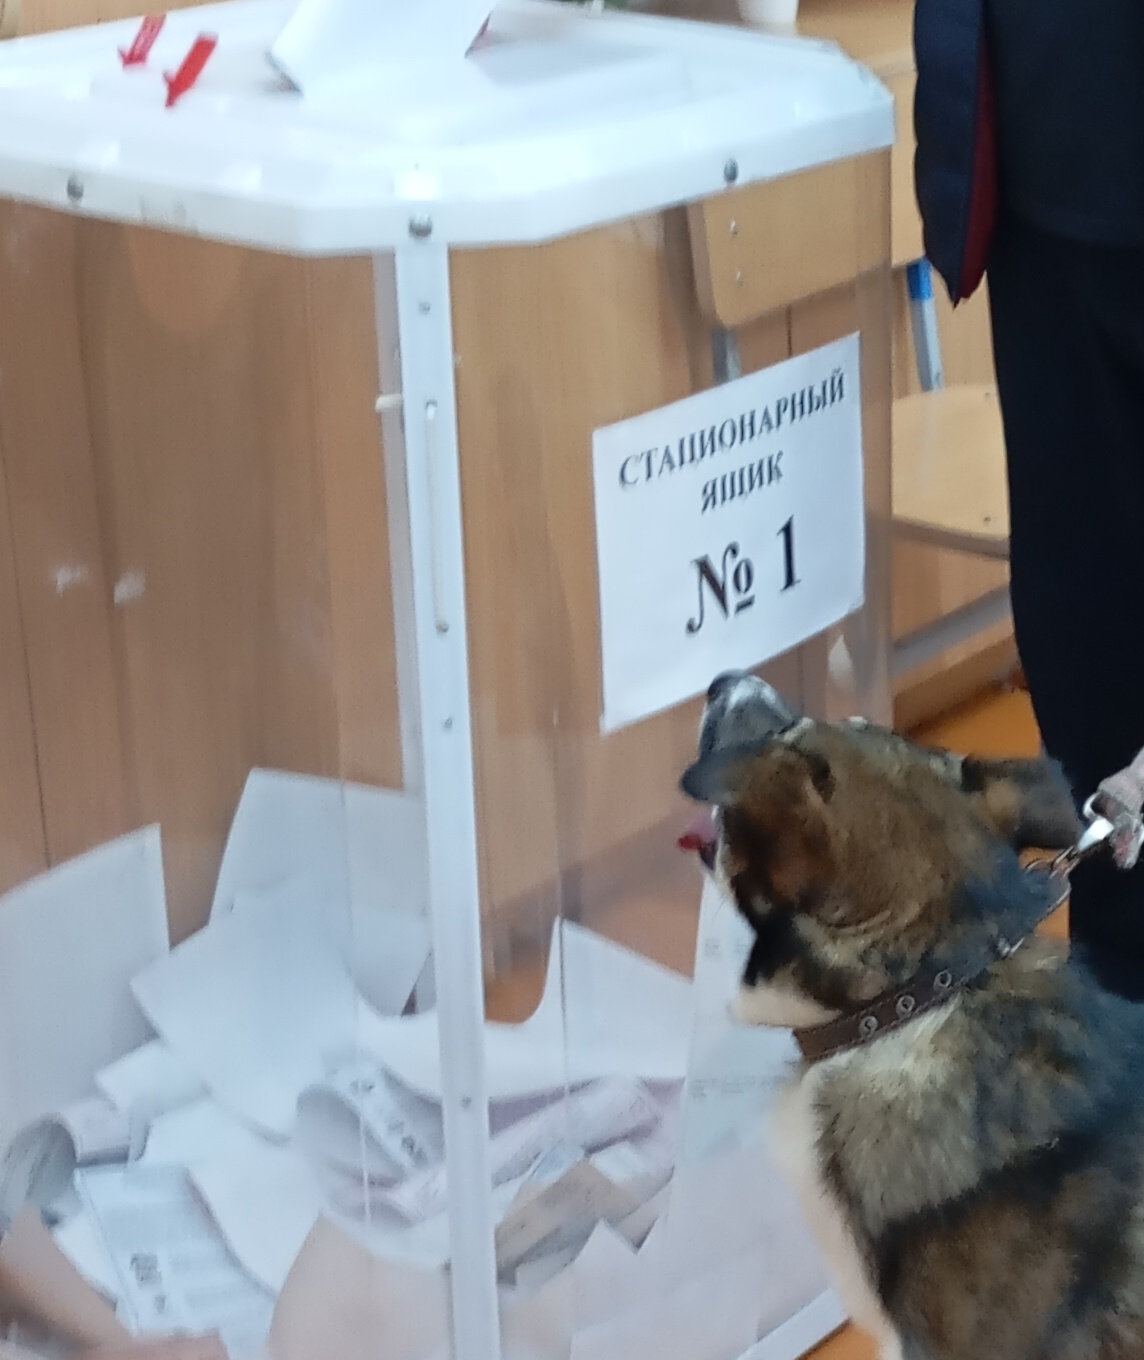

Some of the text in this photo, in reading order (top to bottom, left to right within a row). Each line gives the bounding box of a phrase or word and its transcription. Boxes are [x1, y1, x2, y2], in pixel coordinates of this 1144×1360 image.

[618, 367, 845, 488] СТАЦИОНАРНЫЙ
[701, 450, 784, 514] ЯЩИК
[685, 514, 802, 634] № 1
